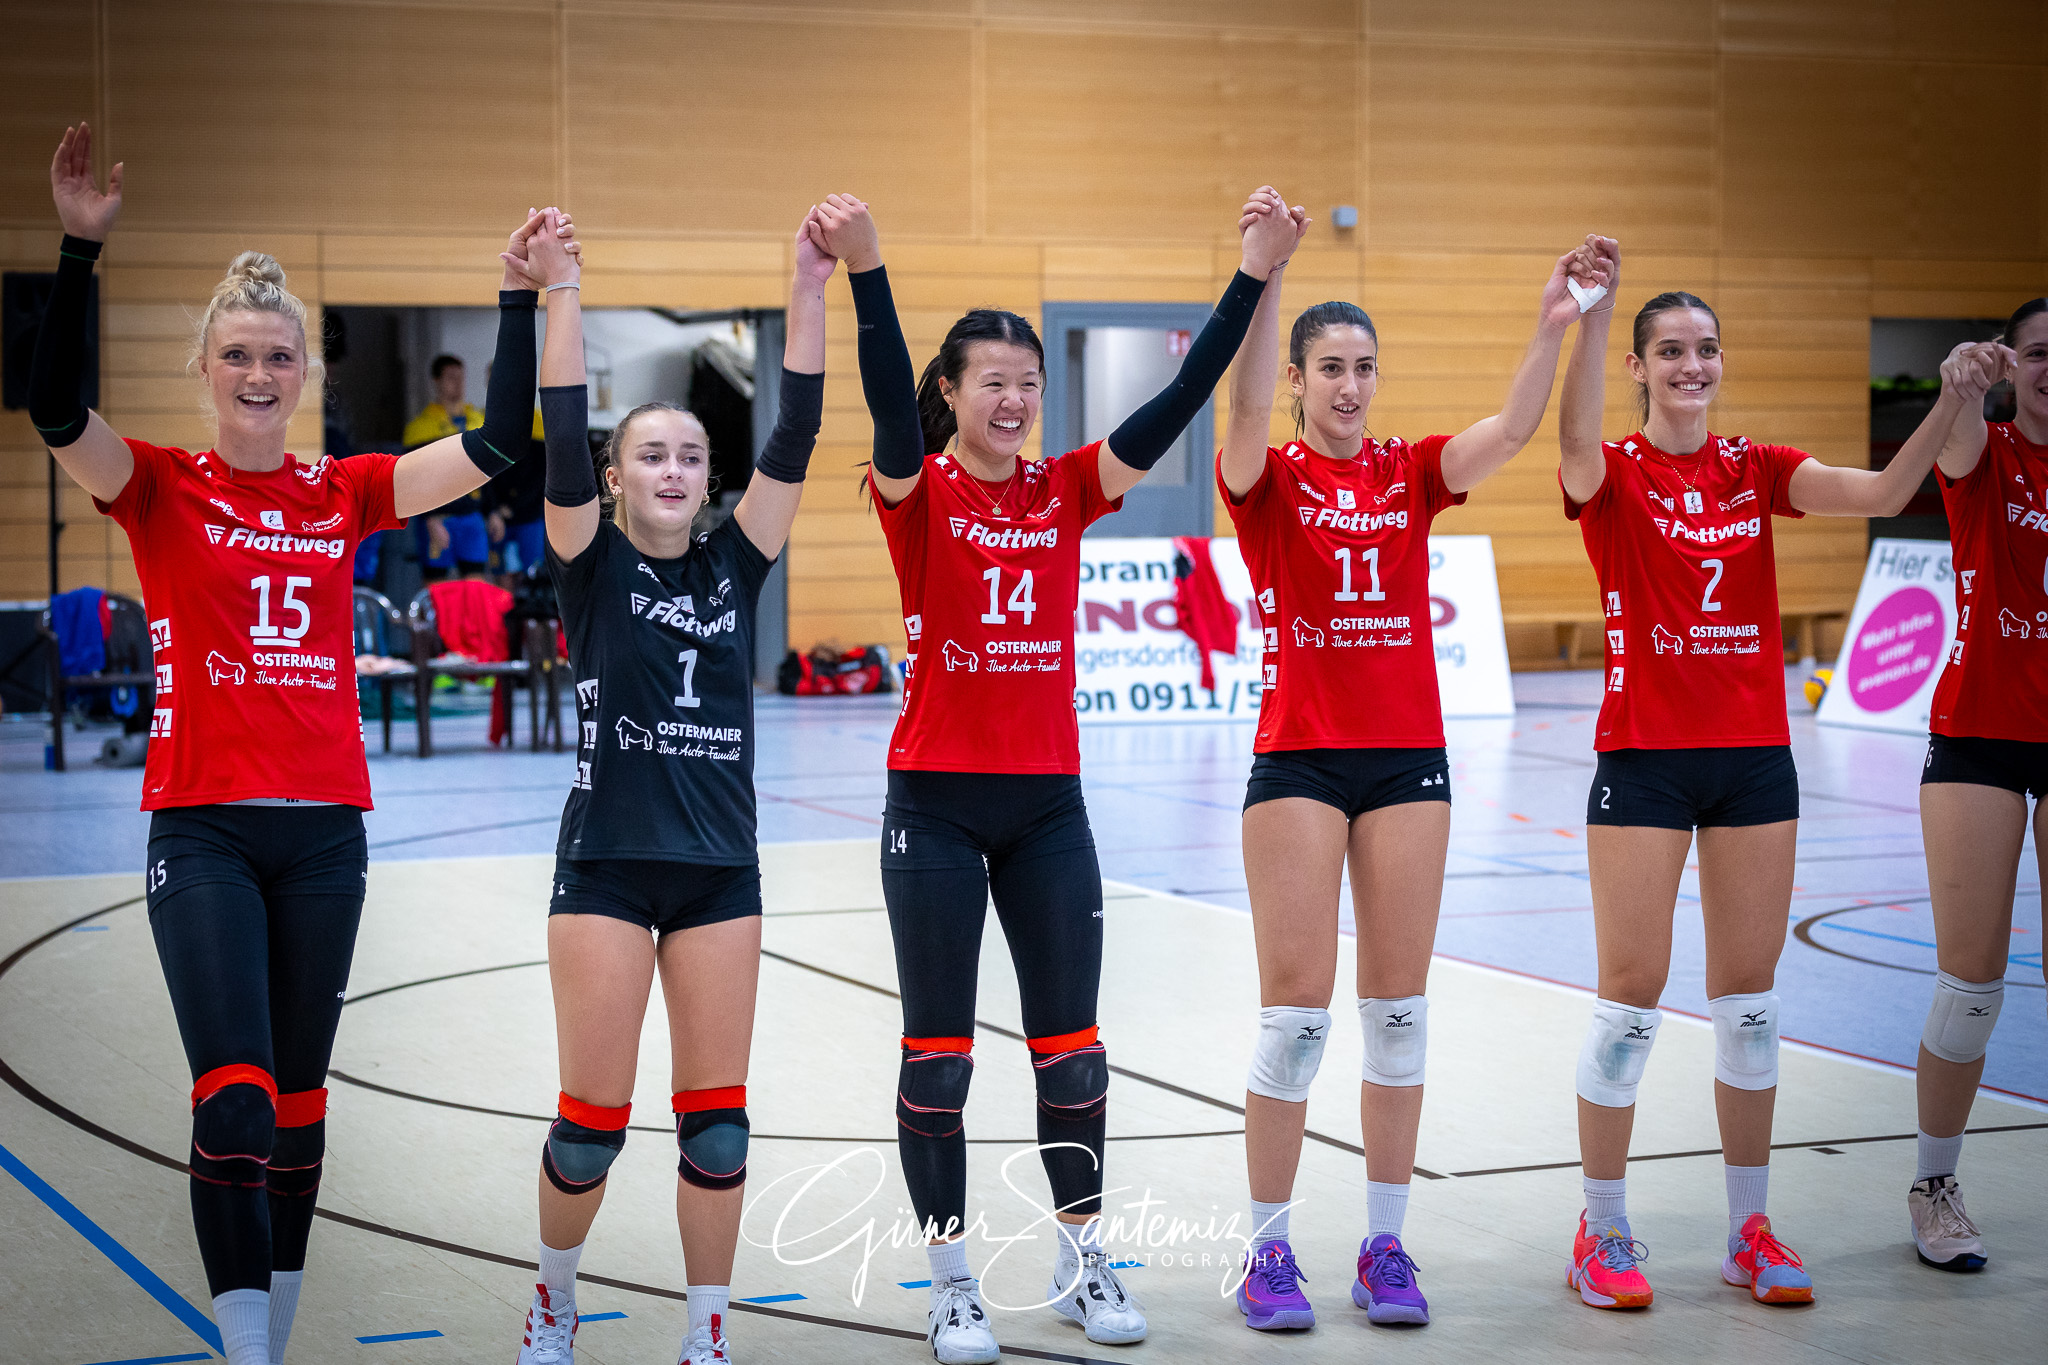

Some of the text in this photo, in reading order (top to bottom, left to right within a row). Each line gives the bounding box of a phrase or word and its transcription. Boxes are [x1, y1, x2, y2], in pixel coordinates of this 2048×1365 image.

[1315, 508, 1408, 532] Flottweg
[1670, 517, 1760, 543] Flottweg
[226, 527, 345, 559] Flottweg
[966, 522, 1058, 549] Flottweg
[1334, 547, 1386, 602] 11
[1875, 546, 1956, 583] Hier s
[981, 566, 1037, 625] 14
[1701, 558, 1724, 612] 2
[249, 575, 313, 639] 15
[1330, 616, 1411, 630] OSTERMAIER
[1689, 624, 1760, 638] OSTERMAIER
[1860, 611, 1935, 650] Mehr Infos
[985, 640, 1062, 655] OSTERMAIER
[1876, 639, 1916, 666] unter
[252, 652, 337, 672] OSTERMAIER
[674, 648, 701, 708] 1
[657, 721, 742, 742] OSTERMAIER
[1600, 786, 1611, 809] 2
[890, 829, 907, 854] 14
[150, 859, 167, 894] 15
